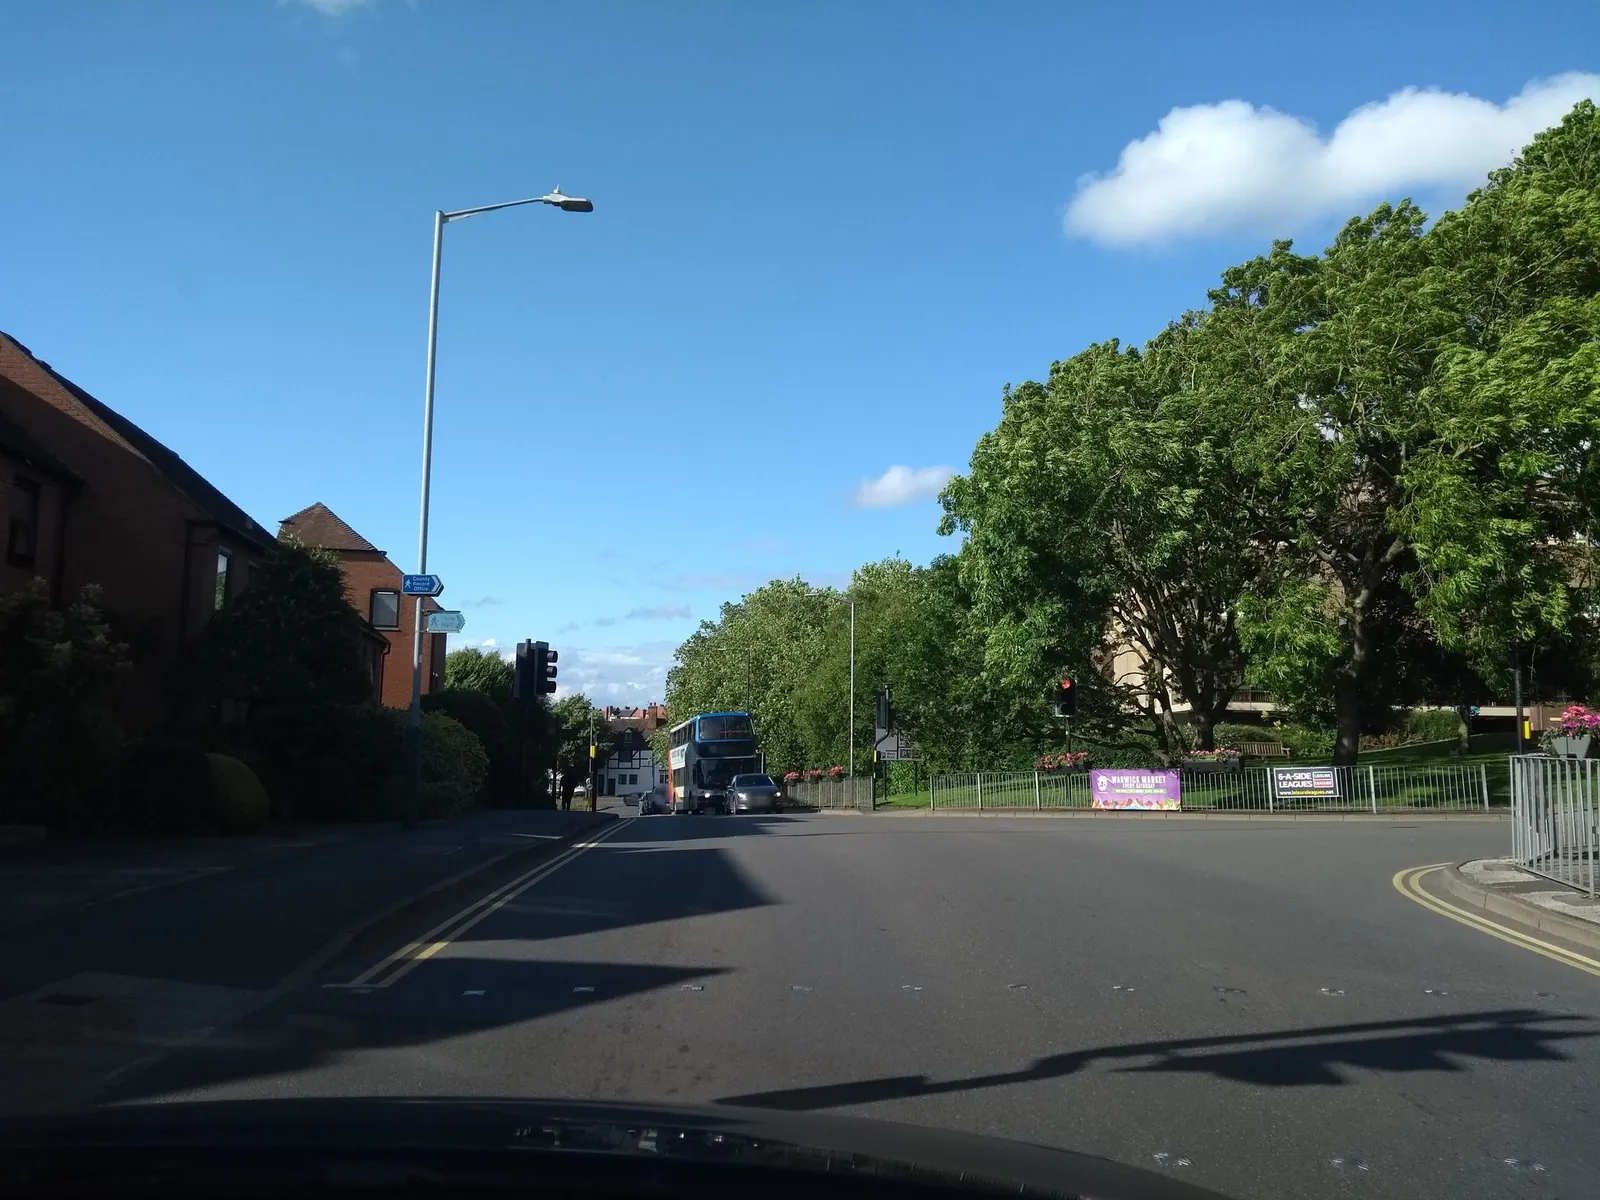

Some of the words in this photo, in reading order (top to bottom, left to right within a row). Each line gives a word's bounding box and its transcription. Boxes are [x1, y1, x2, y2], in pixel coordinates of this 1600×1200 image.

[1111, 775, 1140, 784] WARWICK
[1141, 775, 1166, 784] MARKET
[1278, 772, 1312, 780] 6-A-SIDE
